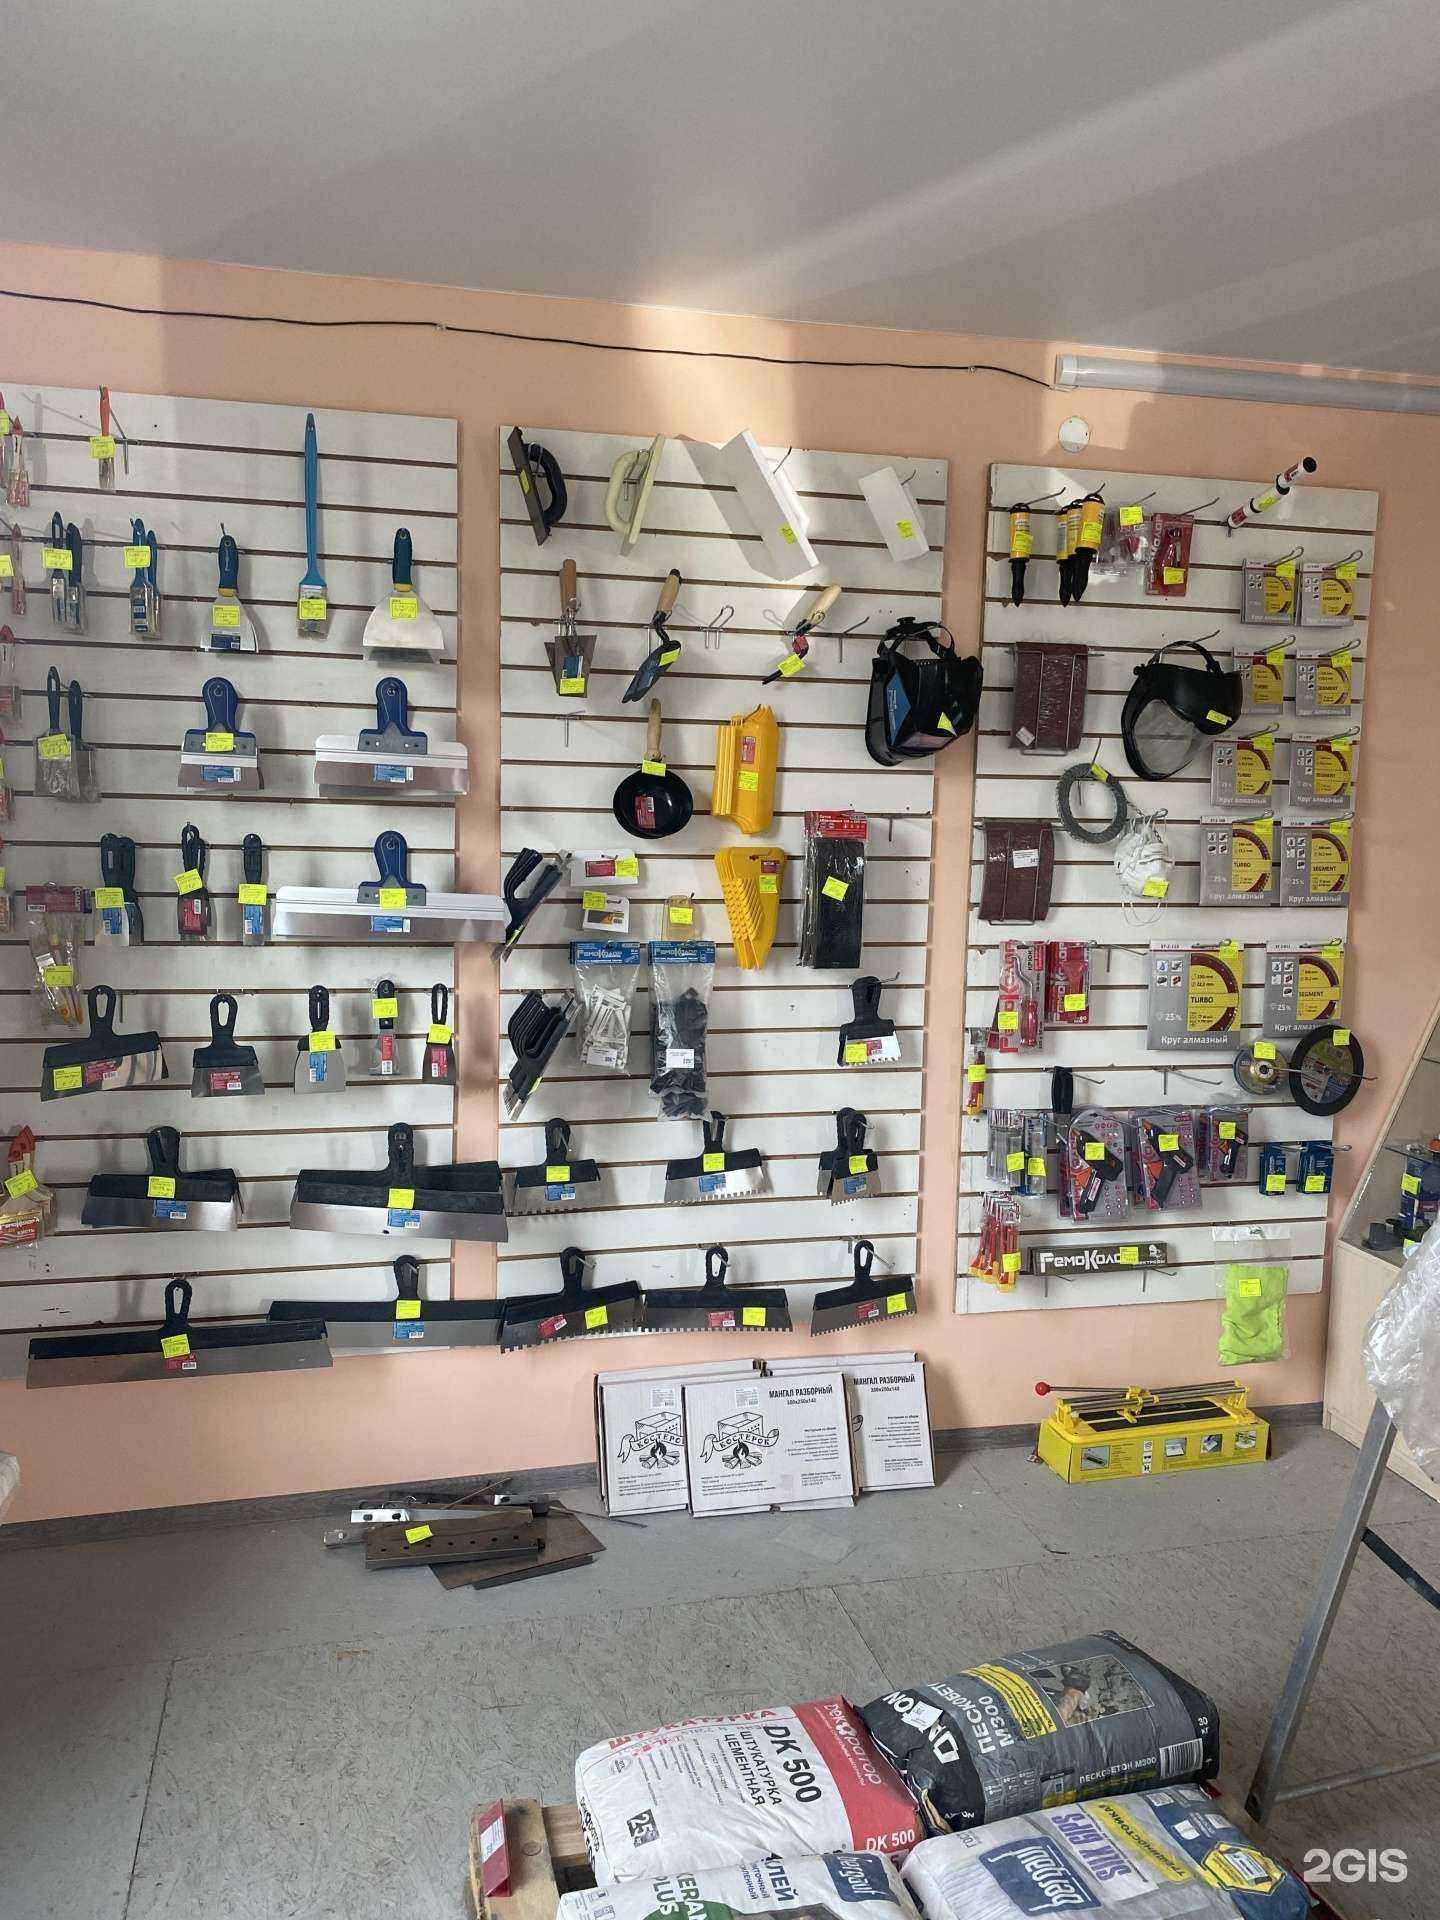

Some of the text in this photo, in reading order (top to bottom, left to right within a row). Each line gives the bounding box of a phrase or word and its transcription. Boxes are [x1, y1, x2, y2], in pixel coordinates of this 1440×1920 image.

[1190, 996, 1214, 1004] TURBO
[1161, 1034, 1228, 1046] Круг алмазный
[1274, 1023, 1292, 1032] Круг
[1039, 1249, 1121, 1274] РемоКоло
[769, 1384, 833, 1399] МАНГАЛ РАЗБОРНЫЙ
[853, 1373, 916, 1386] МАНГАЛ РАЗБОРНЫЙ
[928, 1682, 996, 1755] ПЕСКОБЕТ
[724, 1733, 766, 1806] ЦЕМЕНТНАЯ
[740, 1730, 783, 1805] ШТУКАТУРКА
[763, 1725, 822, 1803] DK 500
[630, 1813, 654, 1838] 25
[1051, 1812, 1103, 1845] GIPS
[866, 1829, 916, 1851] DK 500
